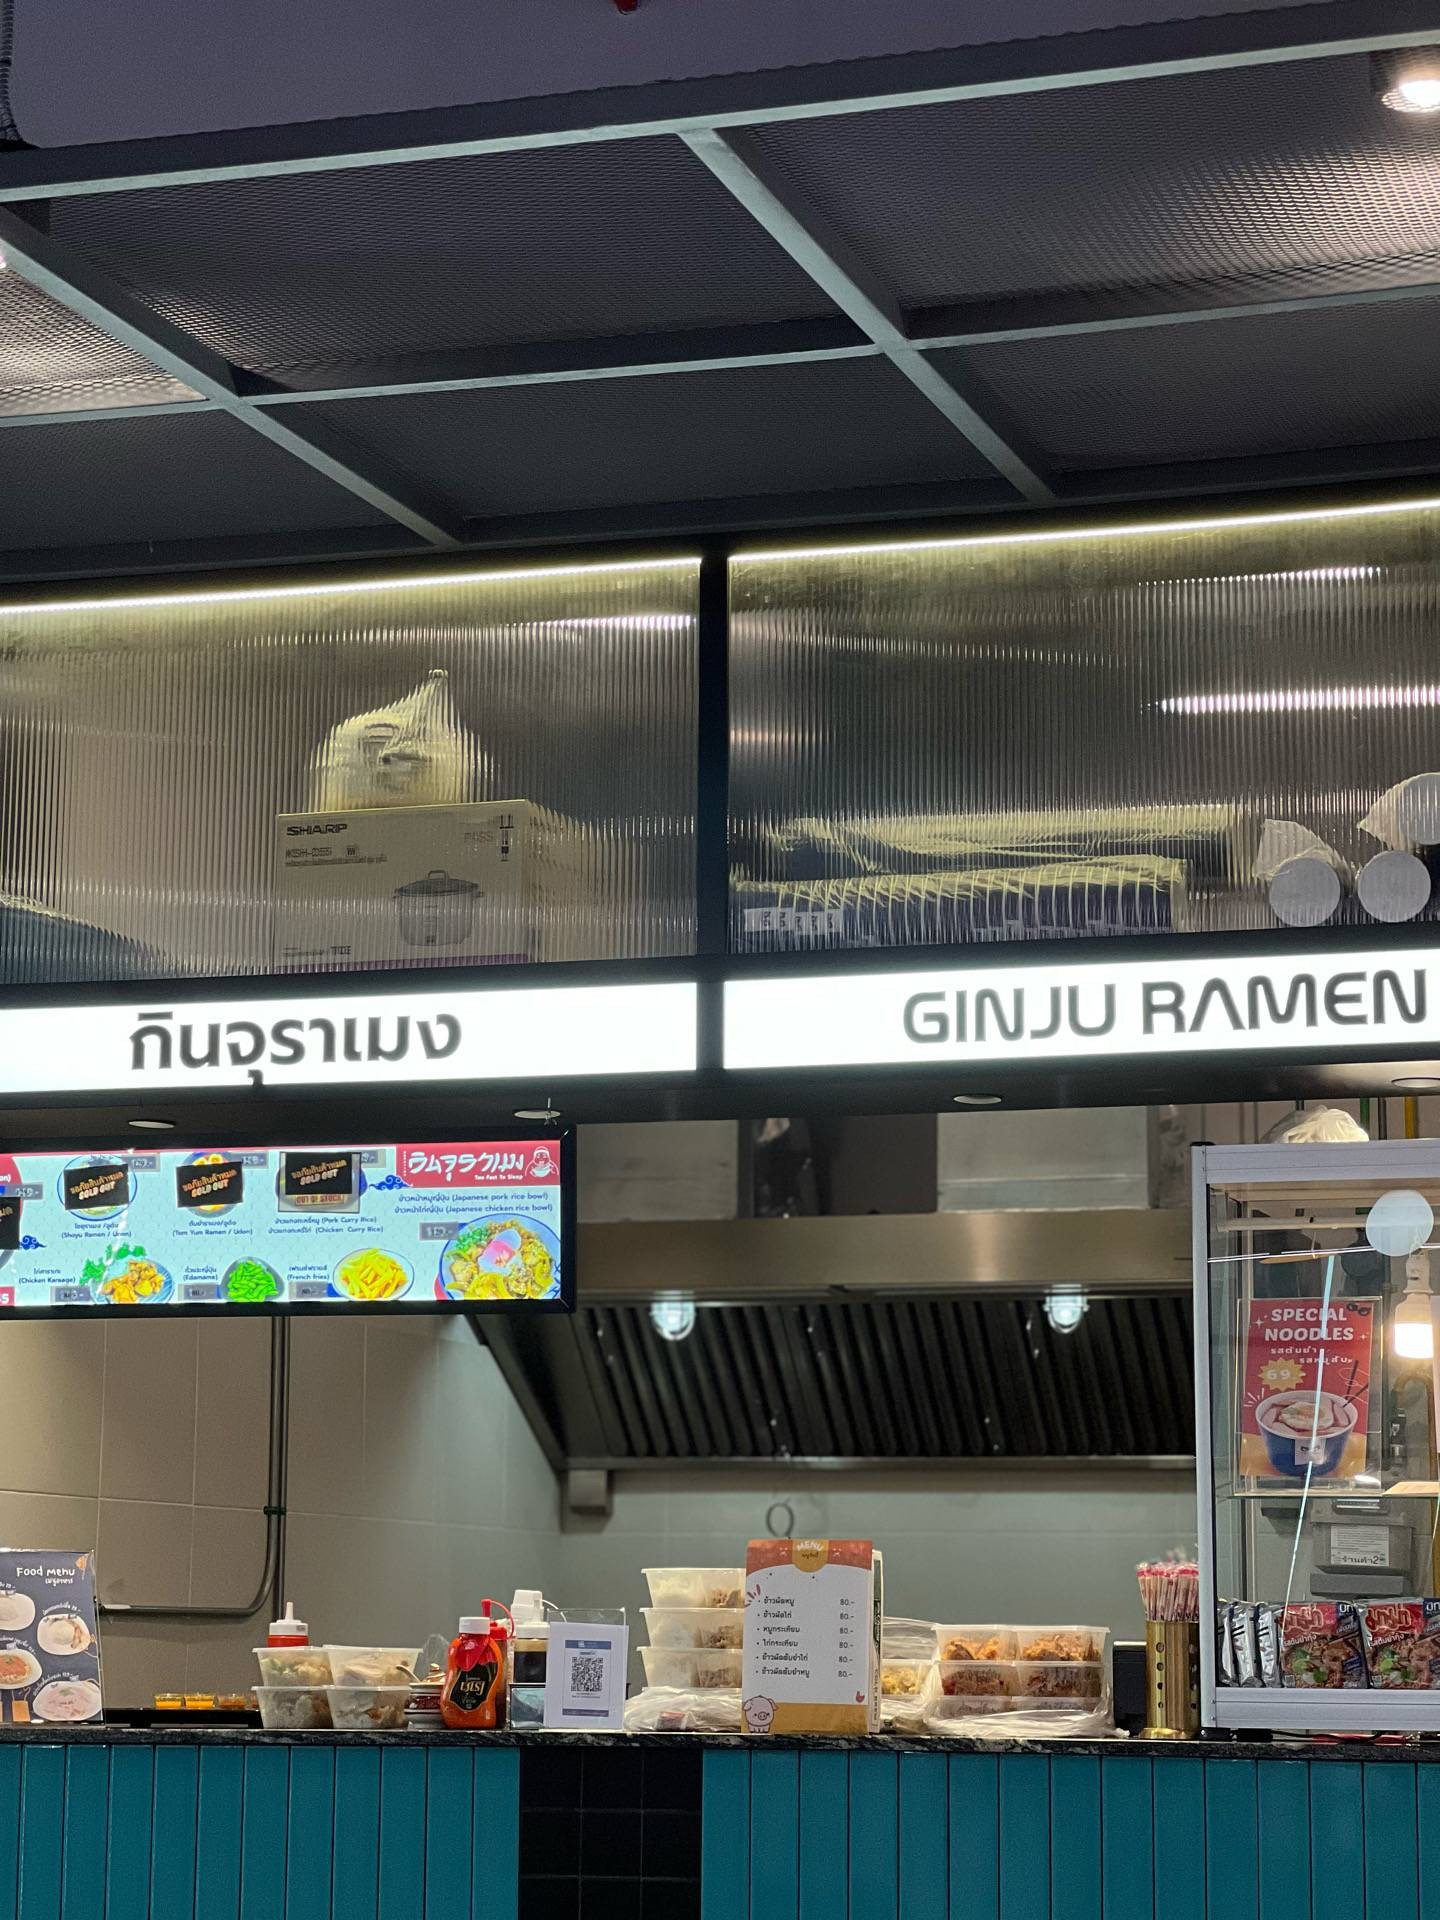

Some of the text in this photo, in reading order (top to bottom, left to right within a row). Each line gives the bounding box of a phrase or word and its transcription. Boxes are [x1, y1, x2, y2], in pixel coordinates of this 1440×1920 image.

[286, 823, 348, 836] SHARP
[902, 968, 1428, 1045] GINJU RAMEN
[300, 1168, 339, 1186] SOLD OUT
[78, 1181, 116, 1201] SOLD OUT
[191, 1179, 229, 1198] SOLD OUT
[451, 1194, 489, 1203] (Japanese
[491, 1194, 509, 1202] pork
[527, 1192, 549, 1201] bowl)
[446, 1205, 483, 1214] (Japanese
[485, 1205, 513, 1213] chicken
[532, 1203, 553, 1212] bowl)
[340, 1216, 358, 1225] Curry
[347, 1226, 366, 1234] Curry
[19, 1277, 46, 1285] (Chicken
[1271, 1308, 1347, 1322] SPECIAL
[1264, 1327, 1354, 1342] NOODLES
[16, 1565, 43, 1577] Food
